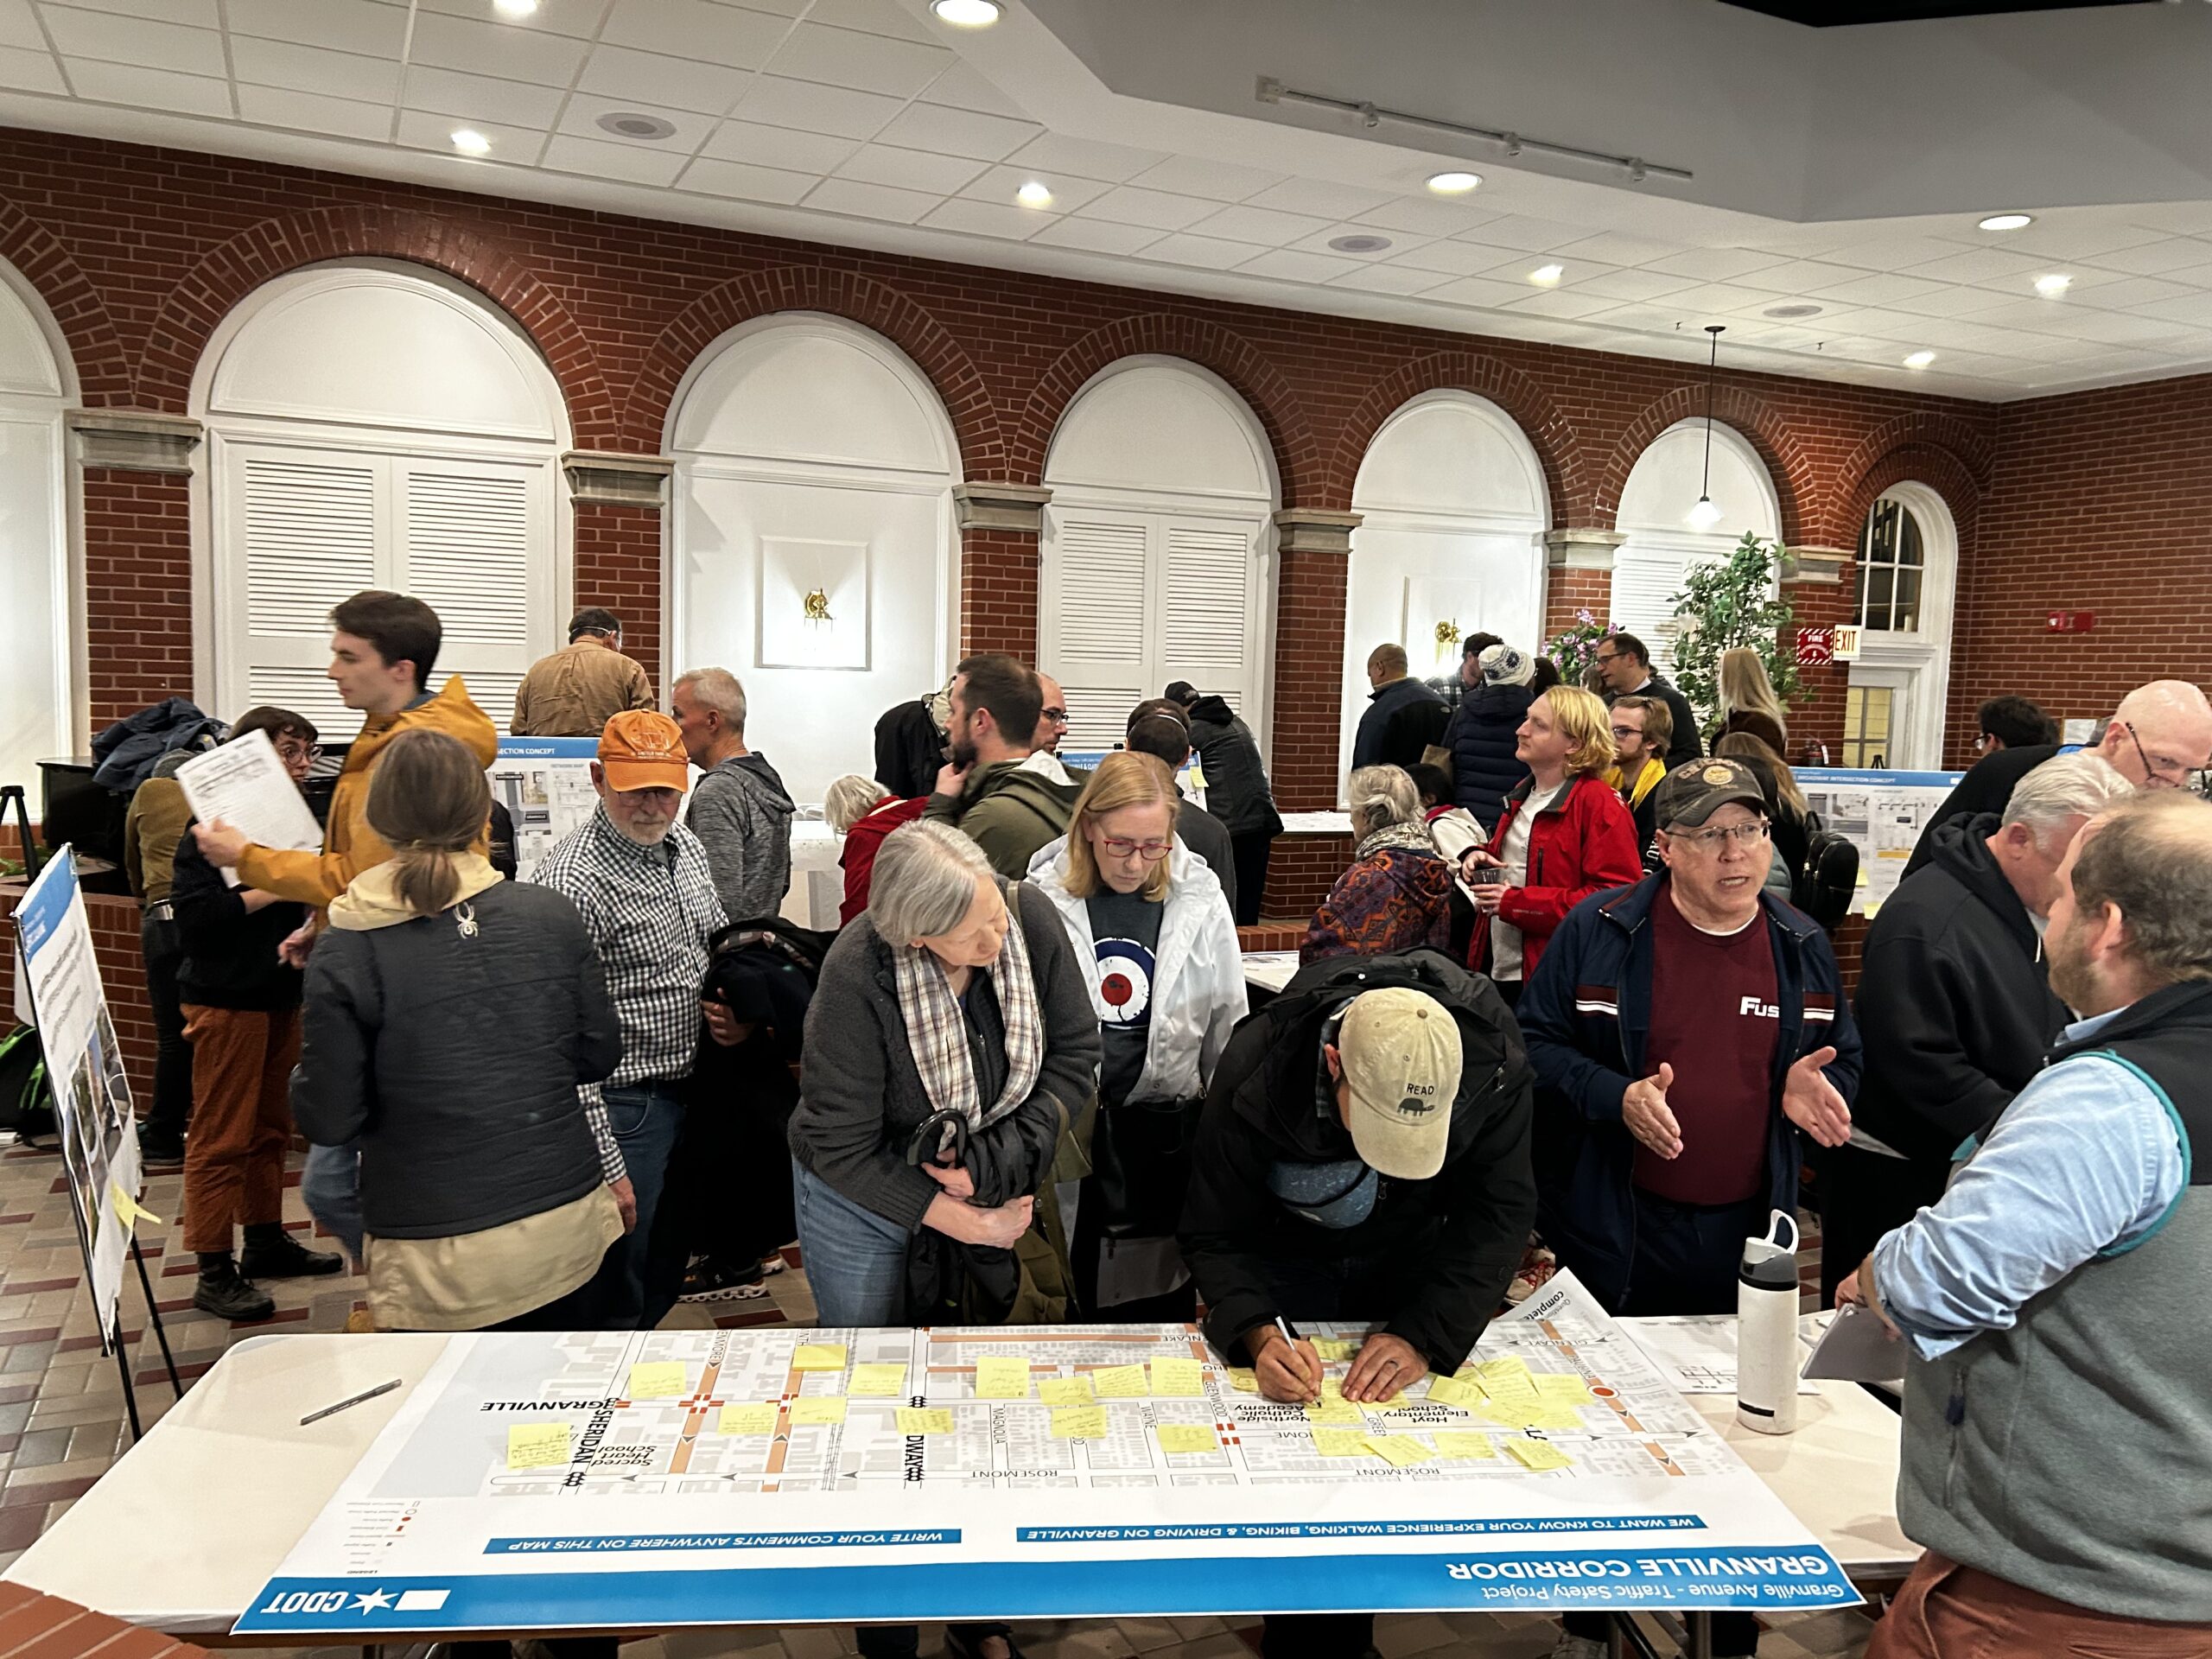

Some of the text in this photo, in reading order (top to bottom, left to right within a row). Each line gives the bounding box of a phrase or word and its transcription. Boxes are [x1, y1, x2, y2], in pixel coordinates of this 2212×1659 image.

[1808, 634, 1824, 643] FIRE
[1834, 630, 1857, 652] EXIT
[1739, 995, 1780, 1018] Fus
[1406, 1083, 1434, 1096] READ
[709, 1331, 728, 1360] ENMORE
[480, 1401, 604, 1411] GRANVILLE
[1140, 1407, 1156, 1429] WAYNE
[992, 1408, 1006, 1445] MAGNOLIA
[1367, 1417, 1388, 1436] GREE
[570, 1408, 613, 1464] SHERIDAN
[904, 1434, 925, 1468] DWAY
[591, 1459, 653, 1467] Sacred
[1354, 1467, 1440, 1476] ROSEMONT
[1386, 1522, 1484, 1535] EXPERIENCE
[1488, 1521, 1535, 1531] YOUR
[1538, 1520, 1588, 1530] KNOW
[1591, 1519, 1615, 1529] TO
[1618, 1519, 1666, 1529] WANT
[1668, 1517, 1694, 1528] WE
[1027, 1529, 1120, 1540] GRANVILLE
[1123, 1529, 1149, 1538] ON
[1153, 1528, 1223, 1538] DRIVING
[1242, 1525, 1300, 1536] BIKING,
[1305, 1524, 1384, 1535] WALKING,
[508, 1532, 944, 1551] WRITE YOUR COMMENTS ANYWHERE ON THIS MAP
[1445, 1554, 1829, 1580] GRANVILLE CORRIDOR
[1481, 1582, 1548, 1601] Project
[1553, 1581, 1610, 1600] Safety
[1616, 1585, 1675, 1599] Traffic
[1688, 1583, 1758, 1599] Avenue
[1764, 1582, 1844, 1599] Granville
[259, 1590, 349, 1614] CDOT
